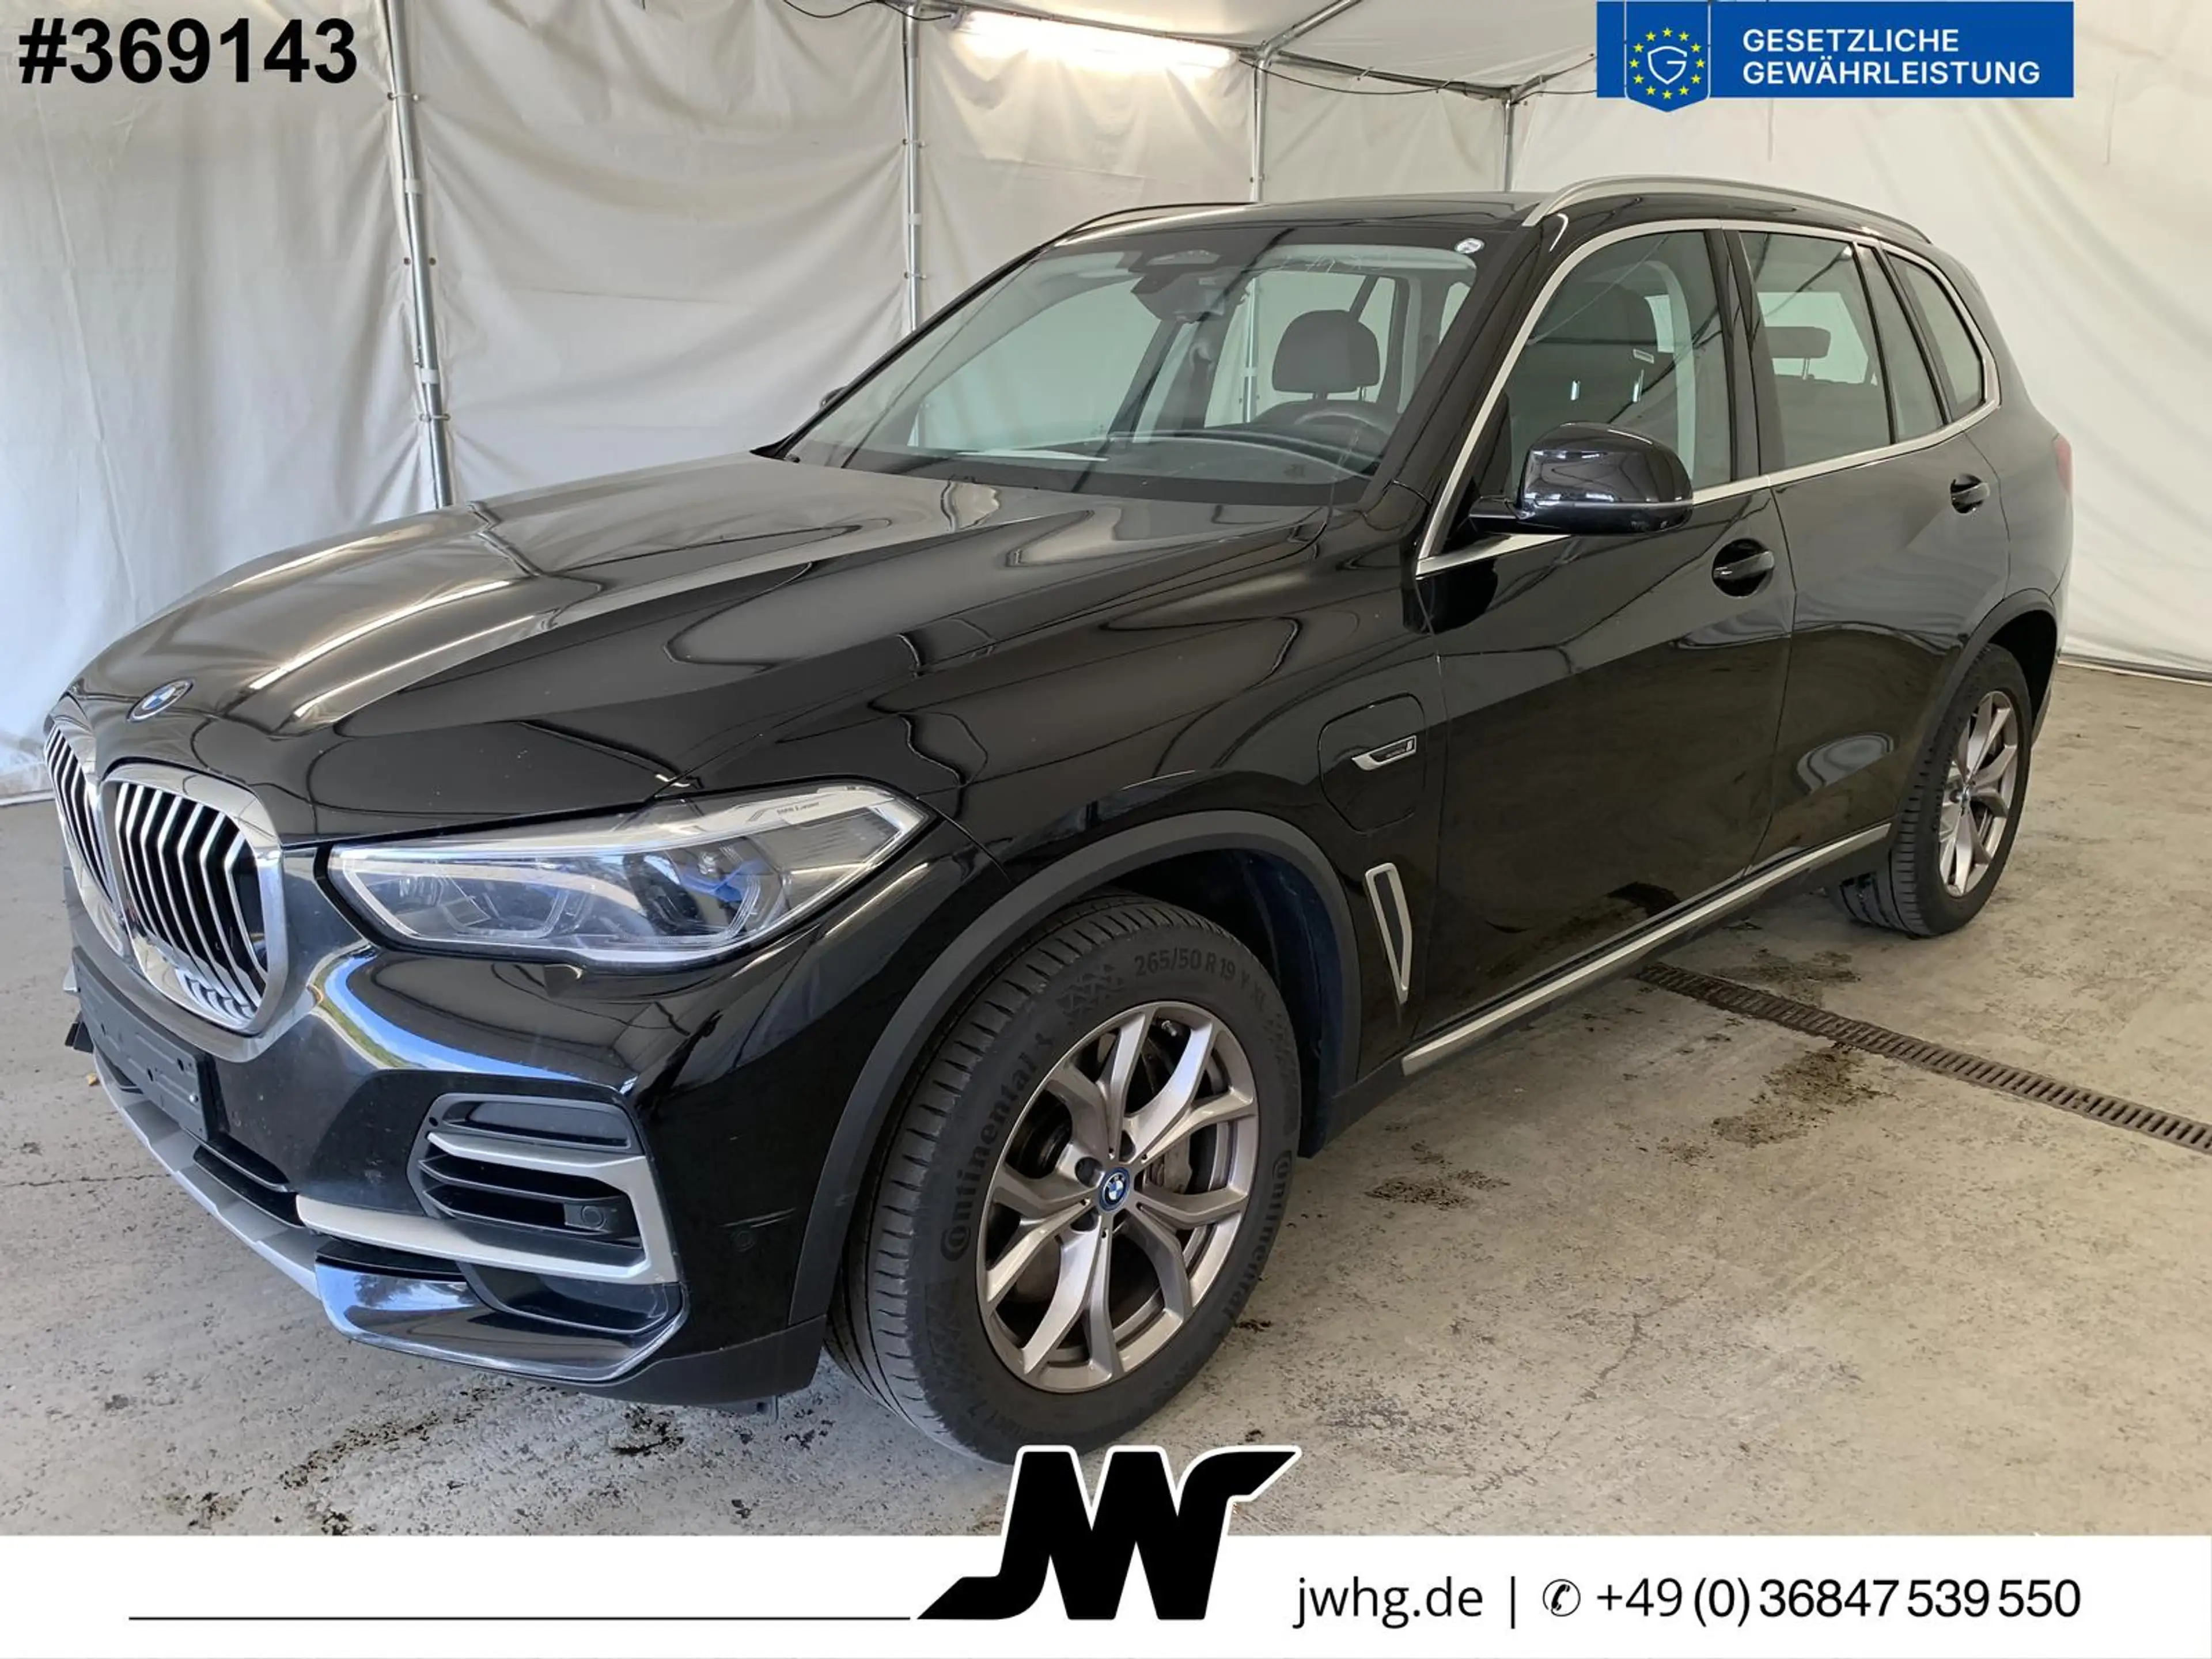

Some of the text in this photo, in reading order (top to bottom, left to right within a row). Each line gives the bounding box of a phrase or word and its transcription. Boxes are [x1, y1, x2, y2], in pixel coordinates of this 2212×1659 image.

[1134, 948, 1202, 977] 265/50
[1205, 952, 1217, 975] R
[1219, 957, 1236, 982] 19
[940, 1051, 1037, 1262] Continental
